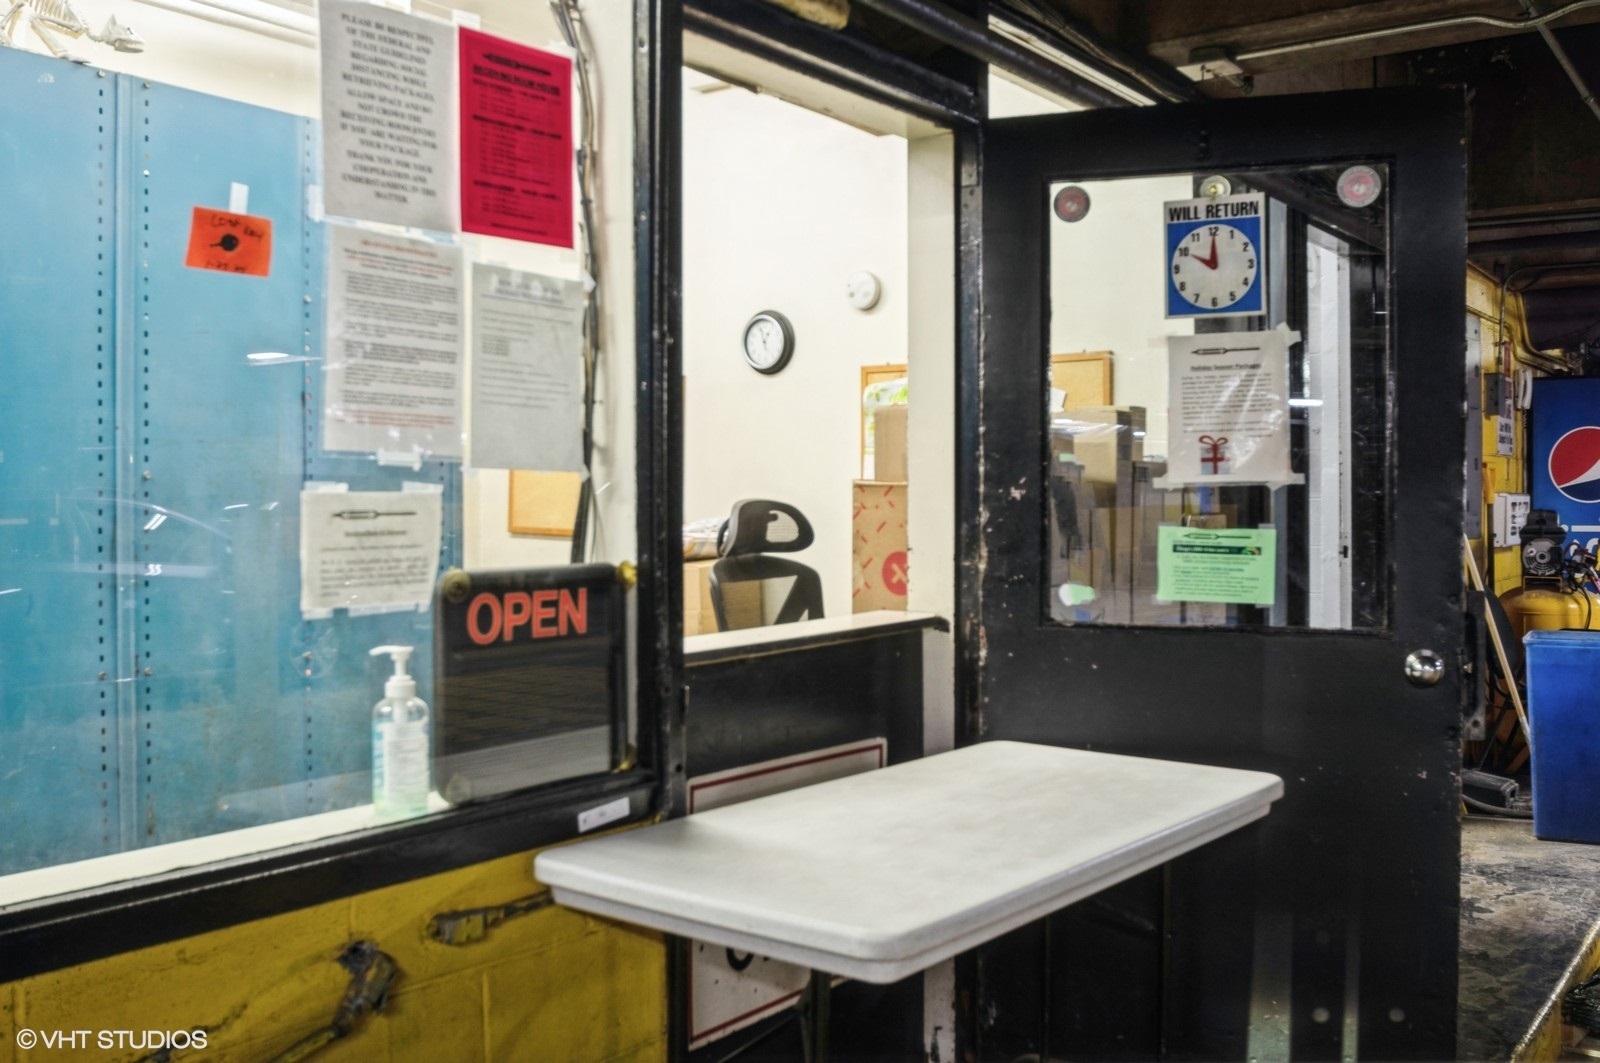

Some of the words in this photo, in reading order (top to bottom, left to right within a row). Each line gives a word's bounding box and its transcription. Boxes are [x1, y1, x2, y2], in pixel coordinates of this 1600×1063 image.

[341, 13, 372, 27] PLEASE
[374, 22, 384, 31] BE
[387, 25, 434, 44] RESPECTFUL
[352, 40, 378, 51] STATE
[360, 29, 376, 40] THE
[378, 34, 413, 49] FEDERAL
[416, 45, 432, 55] AND
[350, 51, 399, 69] REGARDING
[400, 64, 427, 76] SOCIAL
[342, 73, 392, 91] RETRIEVING
[351, 64, 399, 80] DISTANCING
[402, 76, 427, 87] WHILE
[346, 89, 376, 100] ALLOW
[378, 96, 402, 105] SPACE
[341, 110, 385, 126] RECEIVING
[358, 101, 374, 113] NOT
[375, 107, 406, 119] CROWD
[408, 113, 422, 124] THE
[350, 124, 366, 135] YOU
[370, 129, 385, 139] ARE
[387, 133, 421, 145] WAITING
[422, 140, 438, 150] FOR
[359, 139, 382, 149] YOUR
[346, 150, 375, 161] THANK
[376, 156, 393, 166] YOU
[395, 160, 411, 170] FOR
[413, 163, 434, 173] YOUR
[352, 163, 411, 179] COOPERATION
[413, 175, 428, 185] AND
[341, 173, 410, 191] UNDERSTANDING
[1168, 205, 1201, 222] WILL
[1206, 201, 1259, 219] RETURN
[1190, 232, 1201, 242] 11
[1209, 226, 1219, 237] 12
[1229, 229, 1235, 240] 1
[1178, 246, 1190, 257] 10
[1242, 241, 1250, 252] 2
[1173, 264, 1181, 275] 9
[1247, 258, 1255, 270] 3
[1179, 281, 1187, 292] 8
[1242, 277, 1249, 288] 4
[1193, 293, 1200, 304] 7
[1211, 296, 1218, 308] 6
[1229, 291, 1237, 302] 5
[466, 588, 589, 645] OPEN
